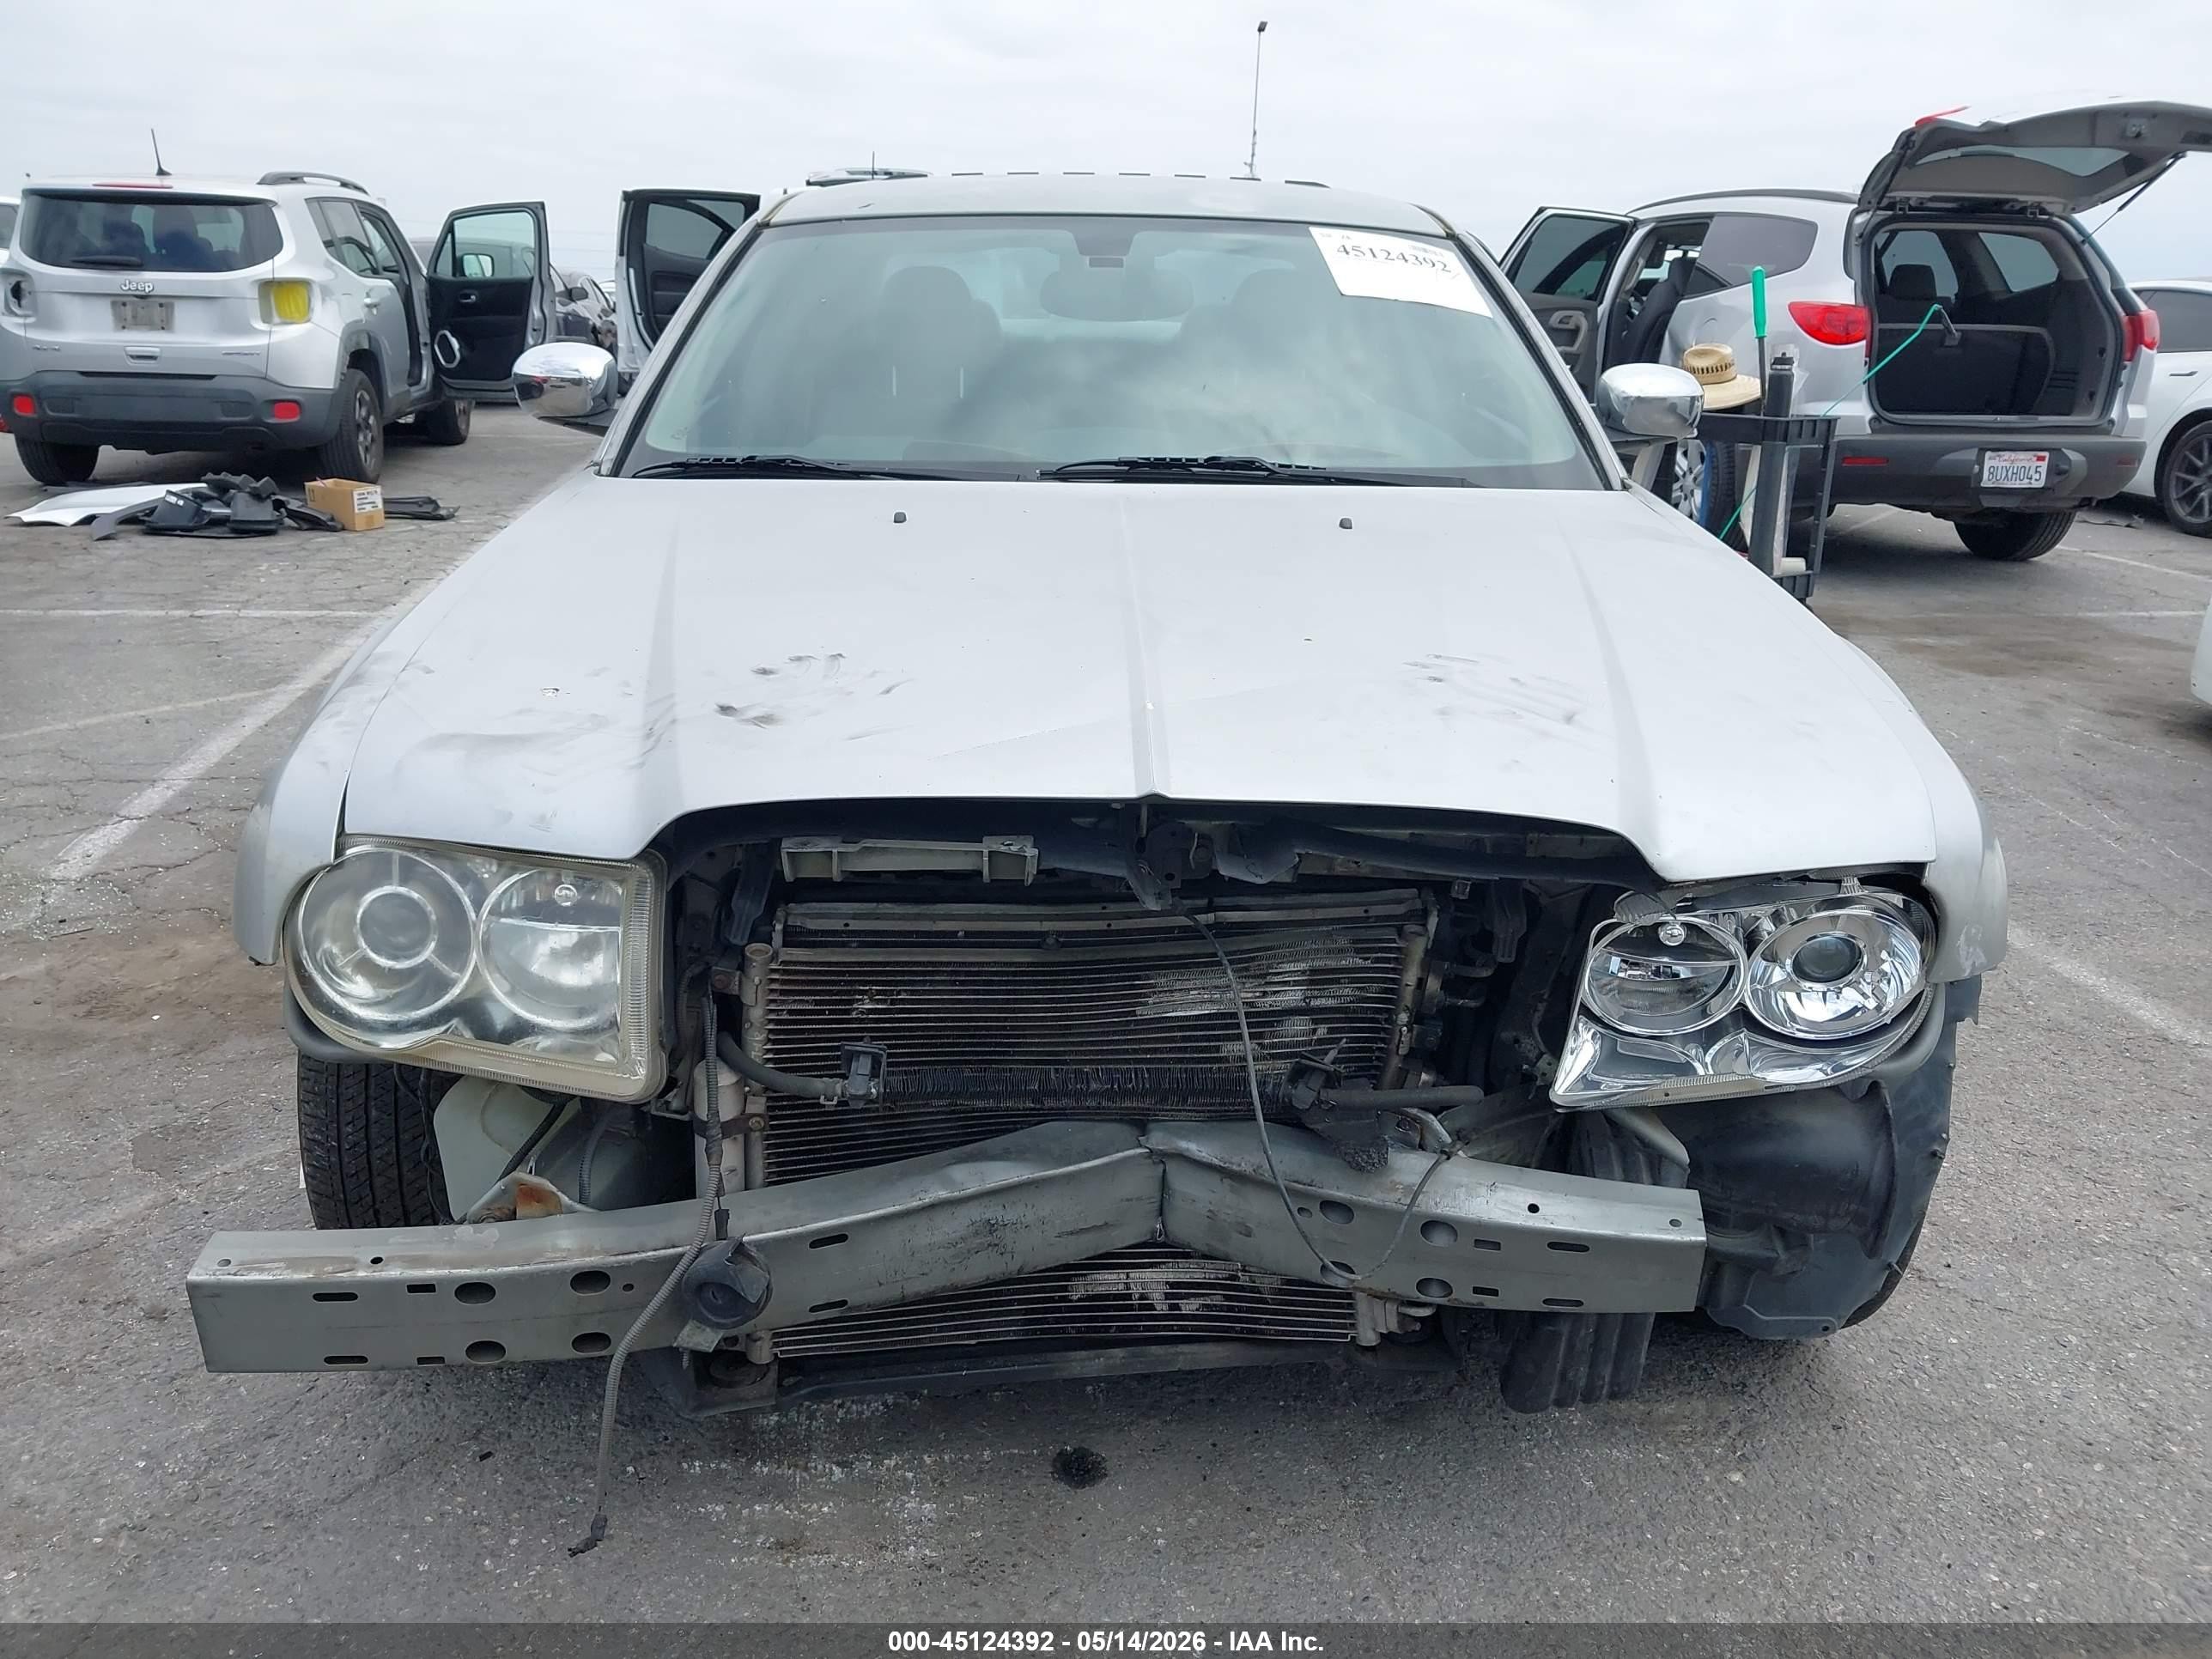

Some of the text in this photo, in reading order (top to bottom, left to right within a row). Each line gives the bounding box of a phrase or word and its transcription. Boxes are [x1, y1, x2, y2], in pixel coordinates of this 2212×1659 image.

[1337, 244, 1451, 273] 45124392
[121, 279, 154, 293] Jeep
[1987, 465, 2042, 482] 8UXH045
